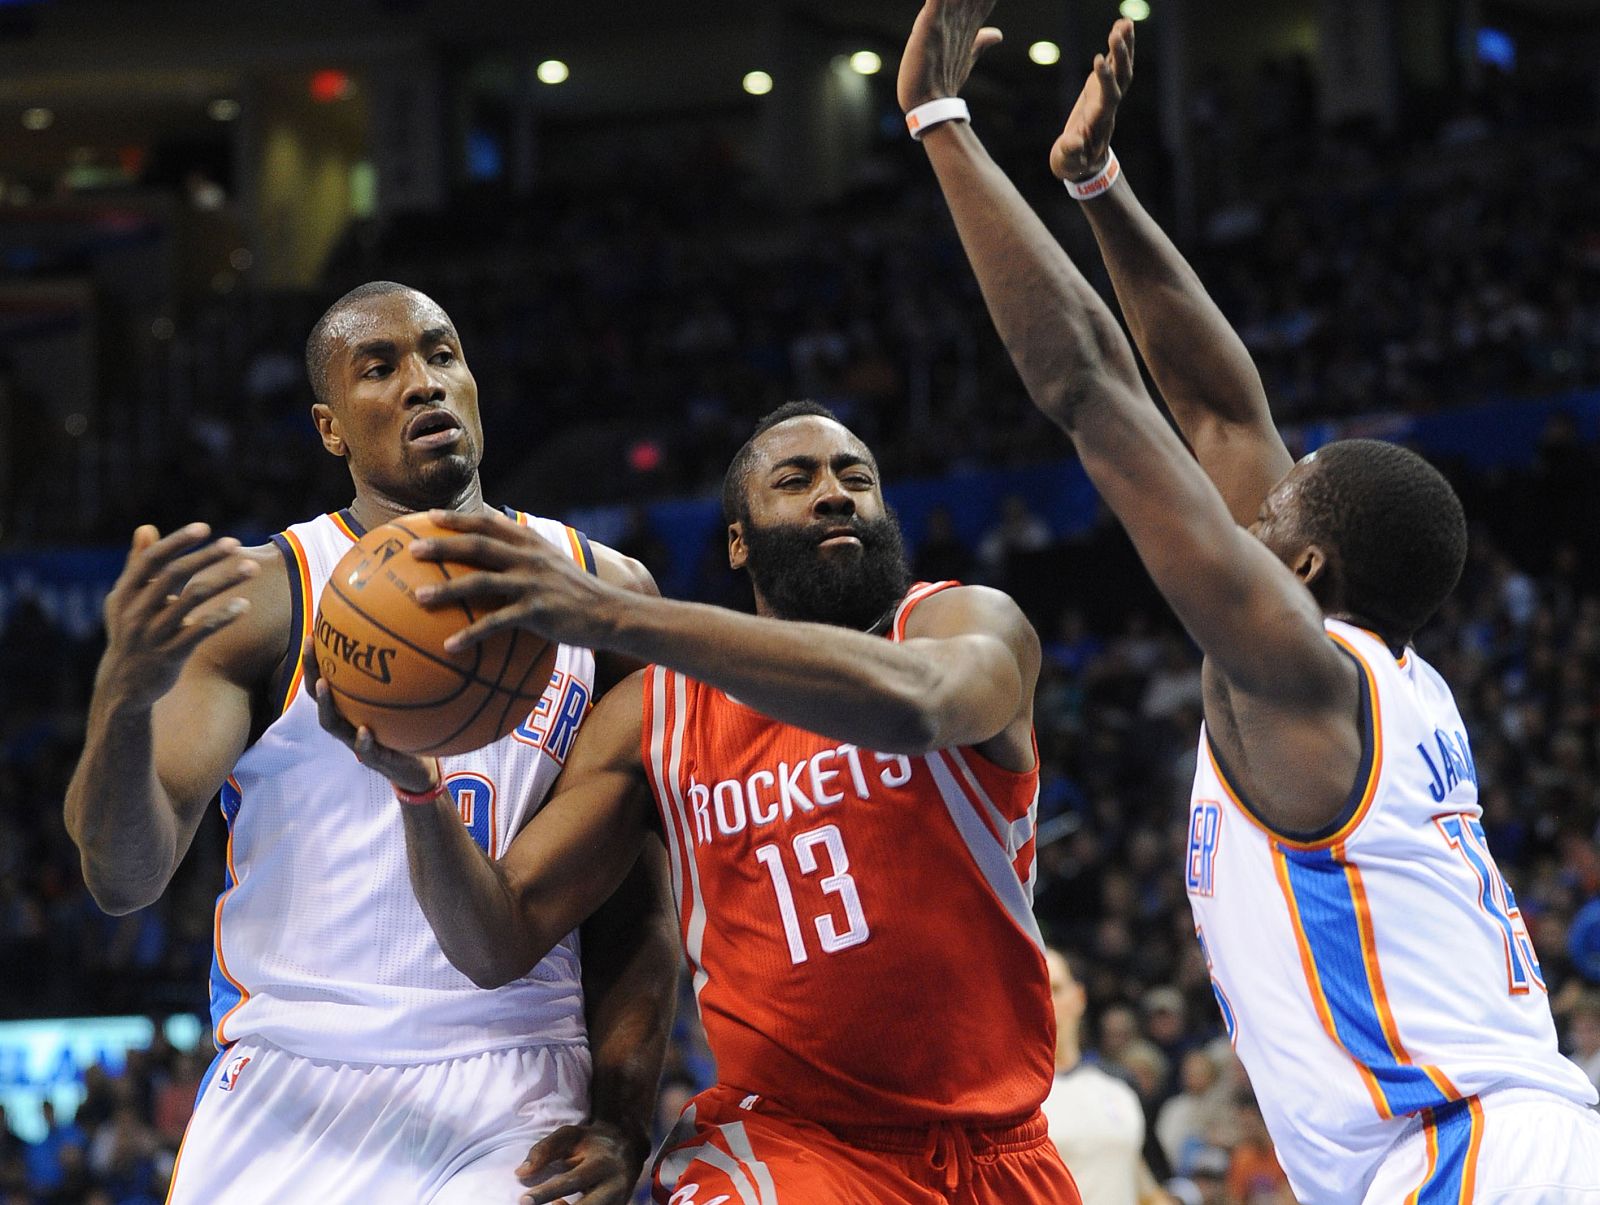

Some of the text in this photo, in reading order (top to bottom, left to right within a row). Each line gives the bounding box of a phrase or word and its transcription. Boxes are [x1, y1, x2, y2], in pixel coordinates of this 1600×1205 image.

[688, 743, 912, 847] ROCKETS
[755, 824, 870, 964] 13
[1186, 800, 1223, 897] ER
